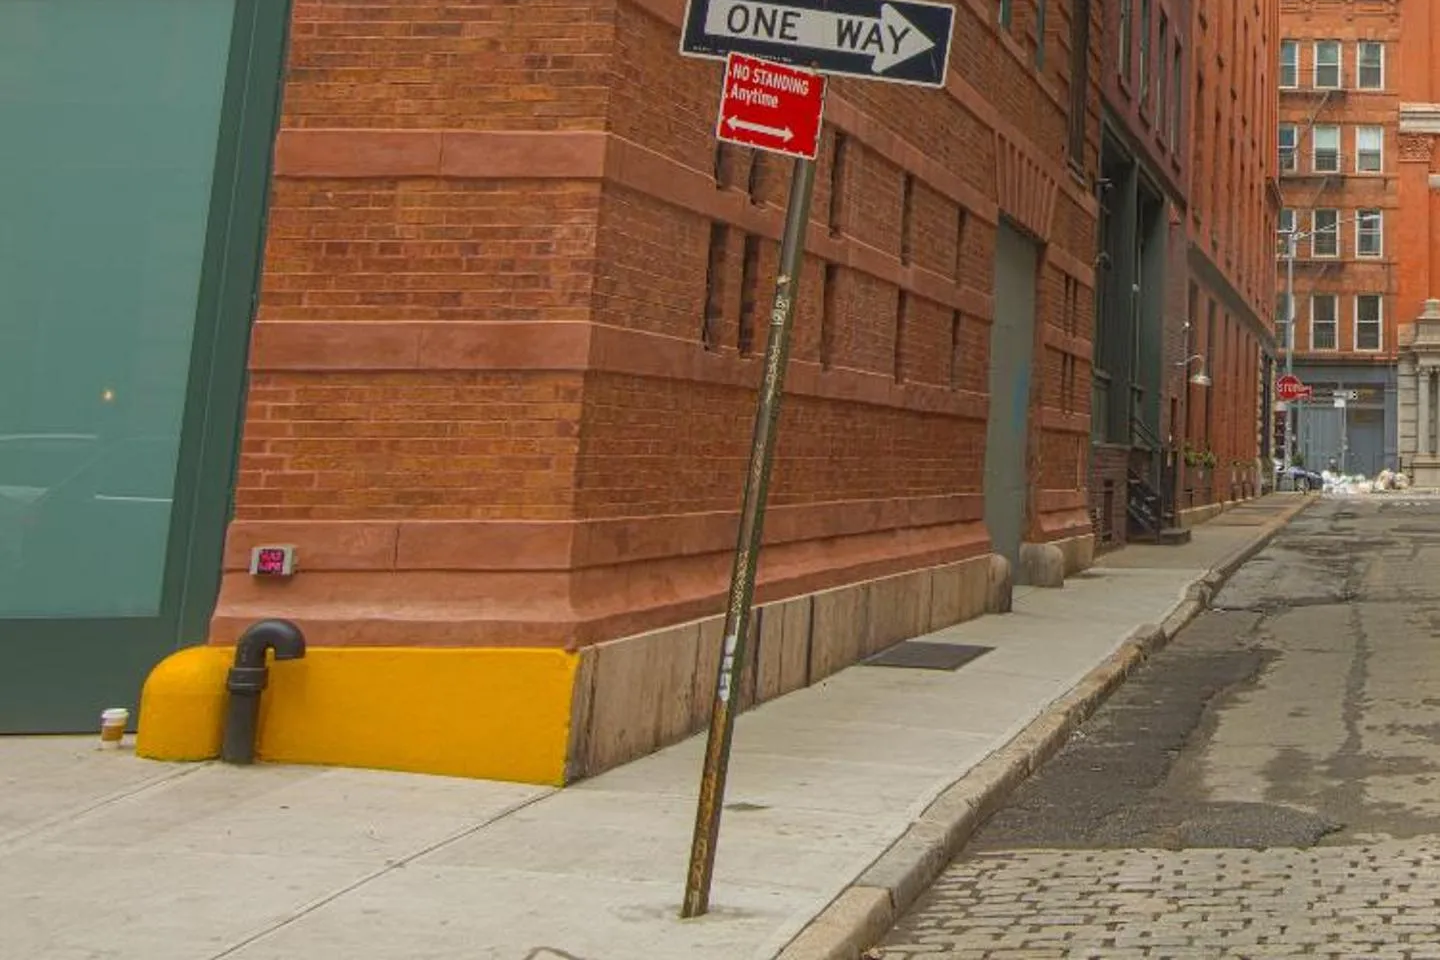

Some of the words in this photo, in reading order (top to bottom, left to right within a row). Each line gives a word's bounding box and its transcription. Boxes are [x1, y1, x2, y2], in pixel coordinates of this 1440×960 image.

[727, 4, 802, 41] ONE
[836, 18, 911, 55] WAY
[730, 83, 779, 109] Anytime
[733, 63, 750, 81] NO
[752, 68, 809, 96] STANDING
